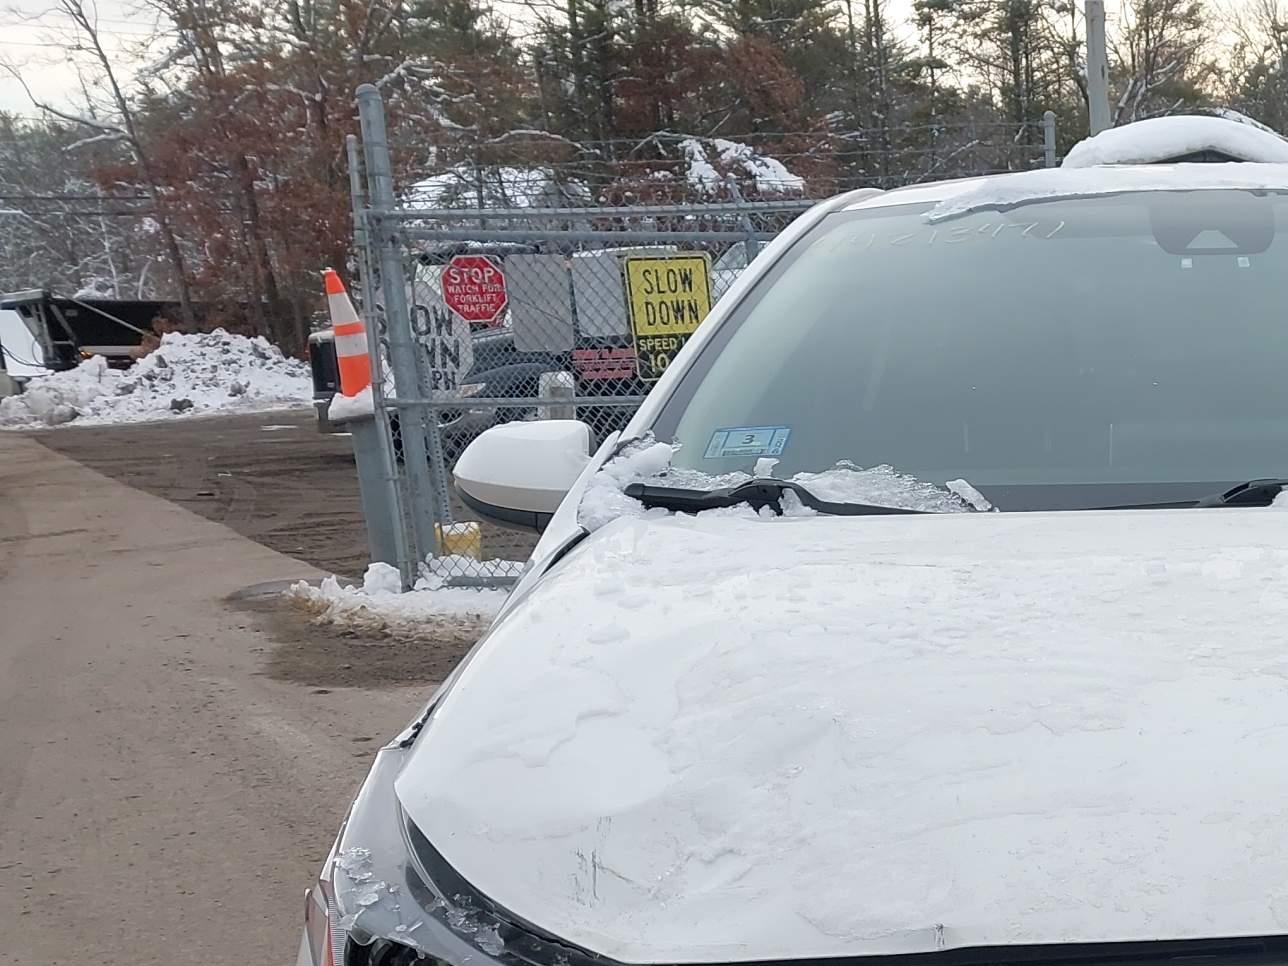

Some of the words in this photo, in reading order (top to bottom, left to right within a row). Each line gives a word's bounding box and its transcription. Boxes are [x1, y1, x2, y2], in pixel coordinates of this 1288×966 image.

[449, 268, 495, 283] STOP
[642, 267, 694, 295] SLOW
[447, 284, 479, 293] WATCH
[482, 284, 501, 293] FOR
[454, 294, 497, 303] FORKLIFT
[457, 304, 496, 313] TRAFFIC
[645, 298, 700, 326] DOWN
[639, 337, 677, 351] SPEED
[650, 352, 670, 373] 10
[741, 434, 755, 445] 3
